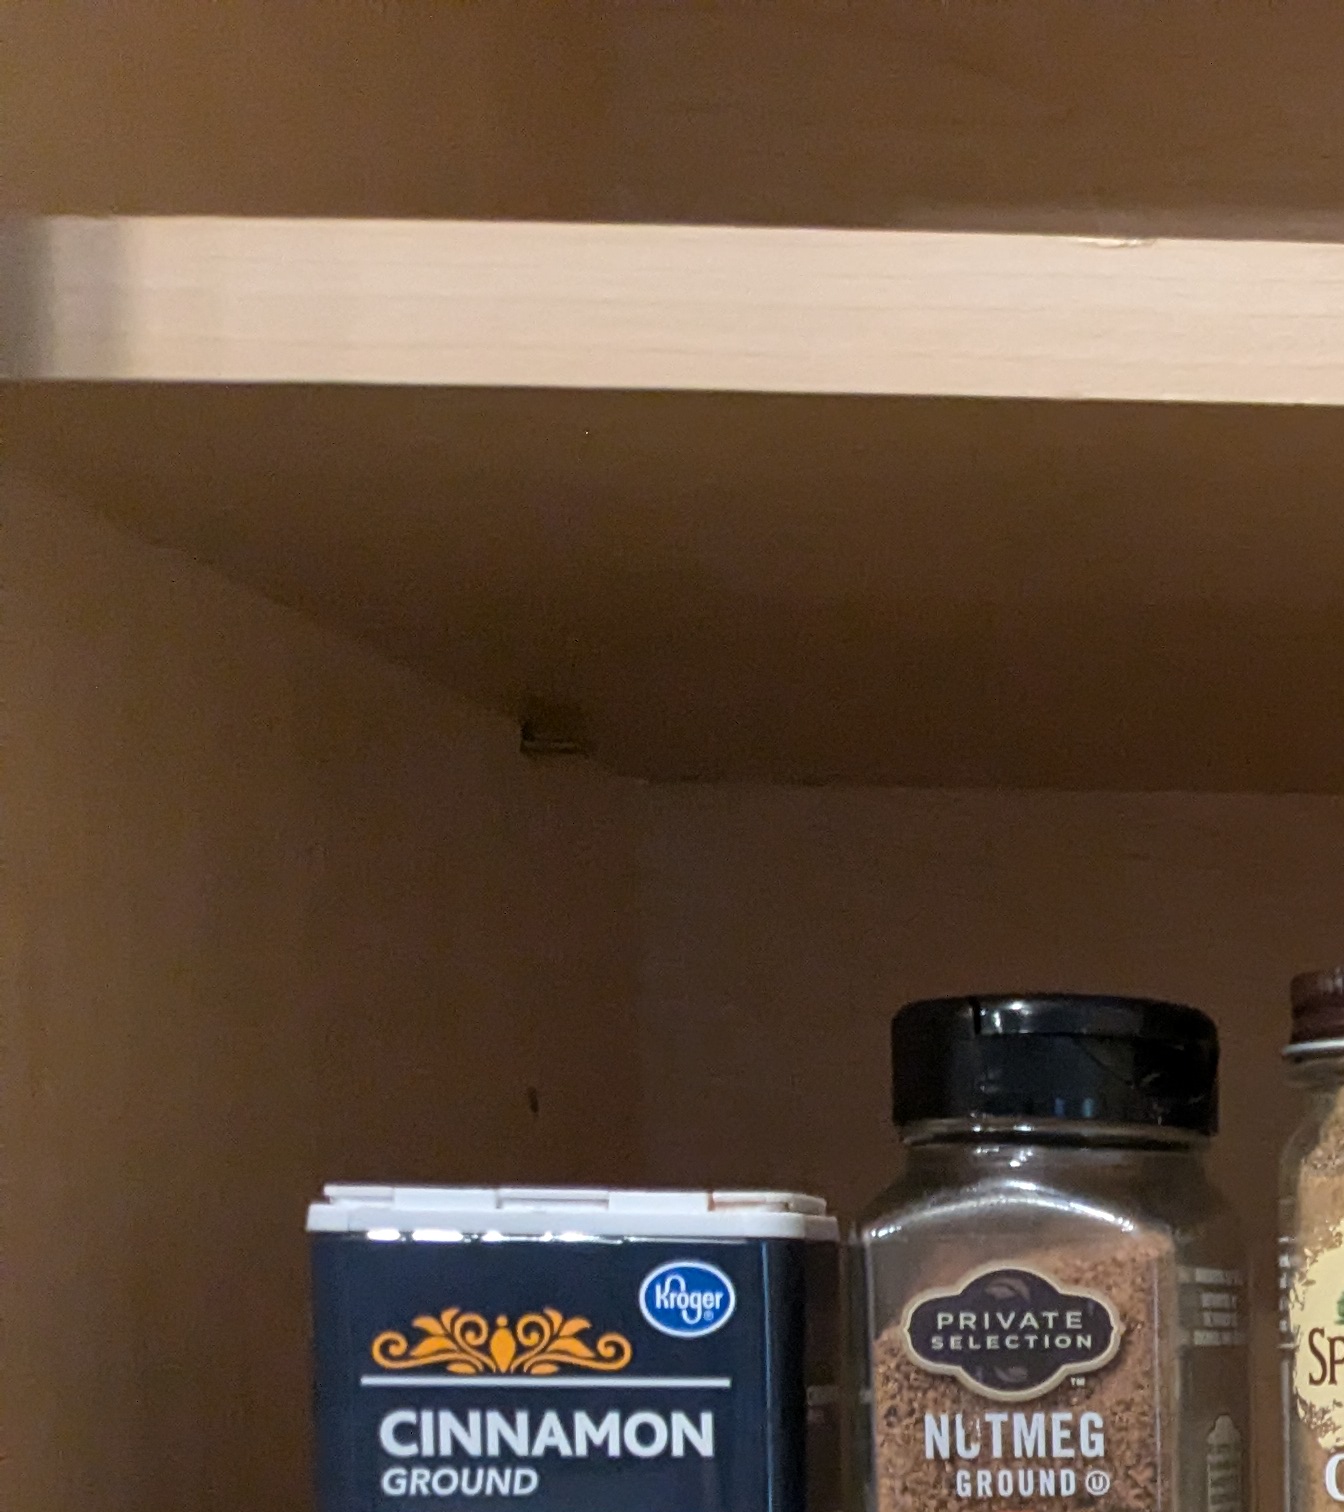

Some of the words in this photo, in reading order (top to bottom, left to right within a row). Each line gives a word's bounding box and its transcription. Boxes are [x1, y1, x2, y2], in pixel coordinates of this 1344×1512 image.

[655, 1272, 724, 1325] Kroger
[937, 1311, 1083, 1331] PRIVATE
[931, 1334, 1092, 1350] SELECTION
[380, 1411, 713, 1457] CINNAMON
[923, 1411, 1105, 1460] NUTMEG
[381, 1467, 540, 1497] GROUND
[956, 1469, 1076, 1498] GROUND
